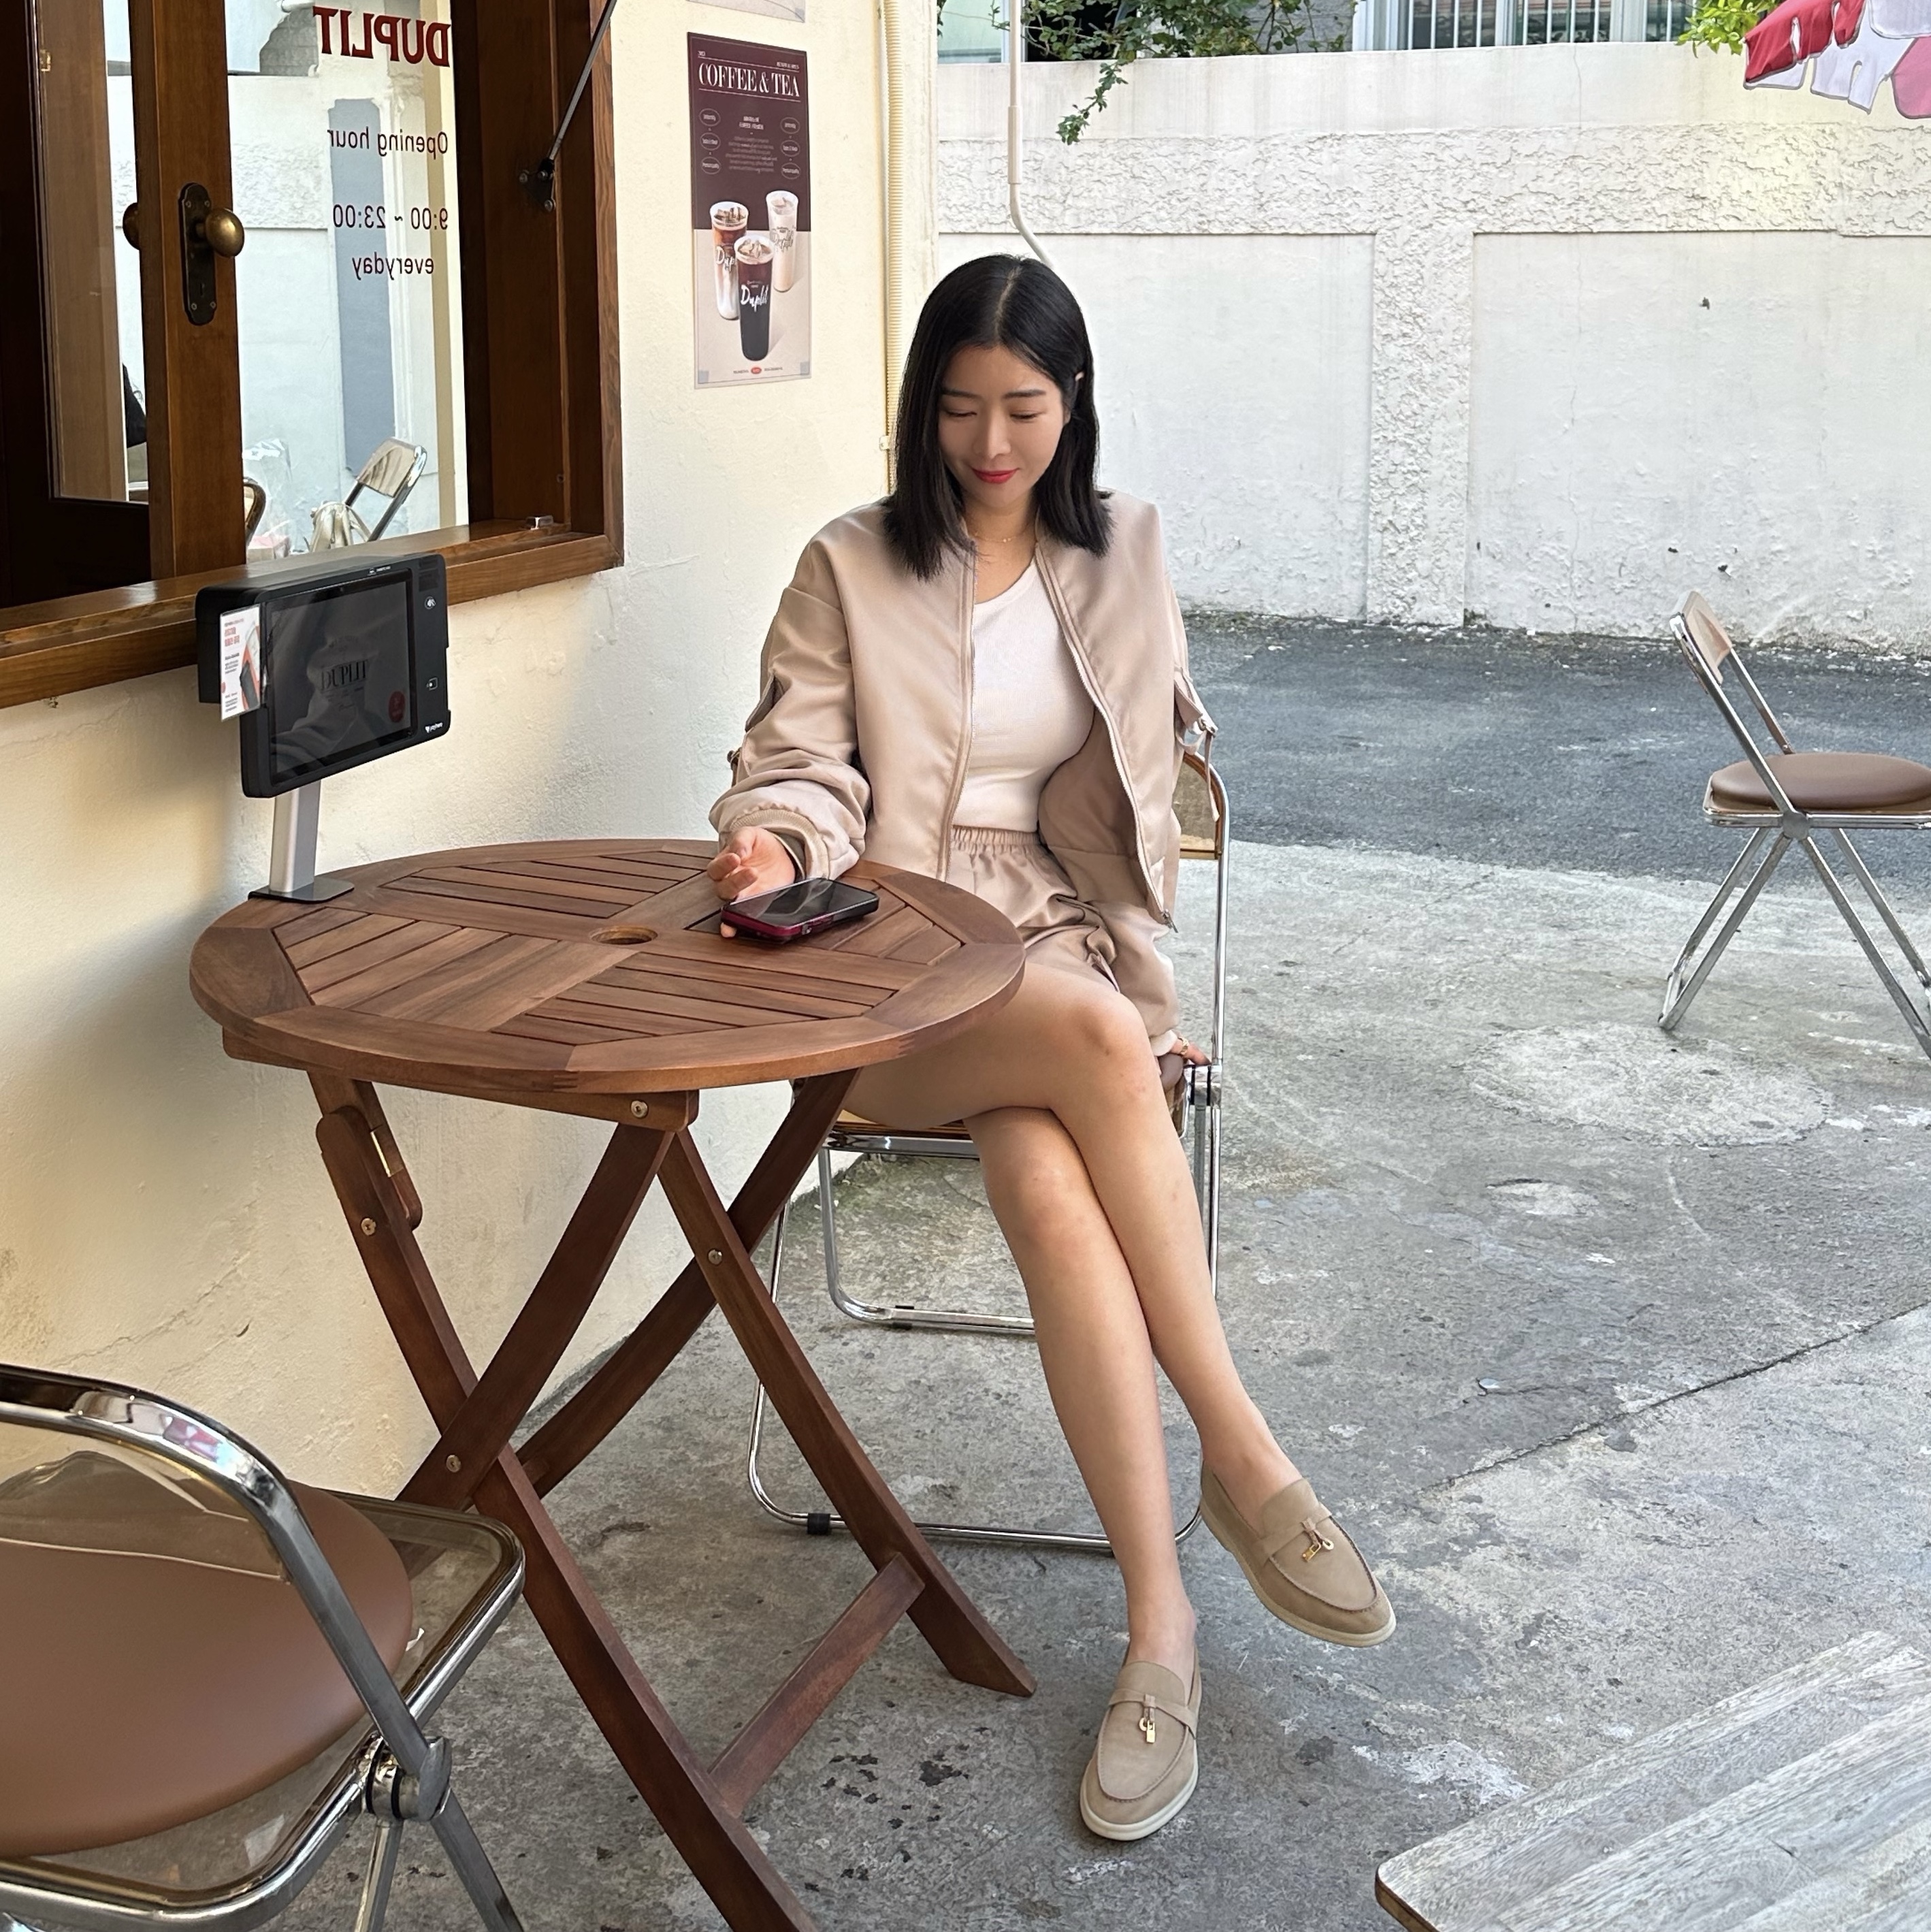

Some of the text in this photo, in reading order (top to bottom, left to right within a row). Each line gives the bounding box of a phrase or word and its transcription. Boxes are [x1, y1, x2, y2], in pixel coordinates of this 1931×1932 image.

[698, 63, 800, 97] COFFEE & TEA
[321, 659, 369, 690] DUPLIT
